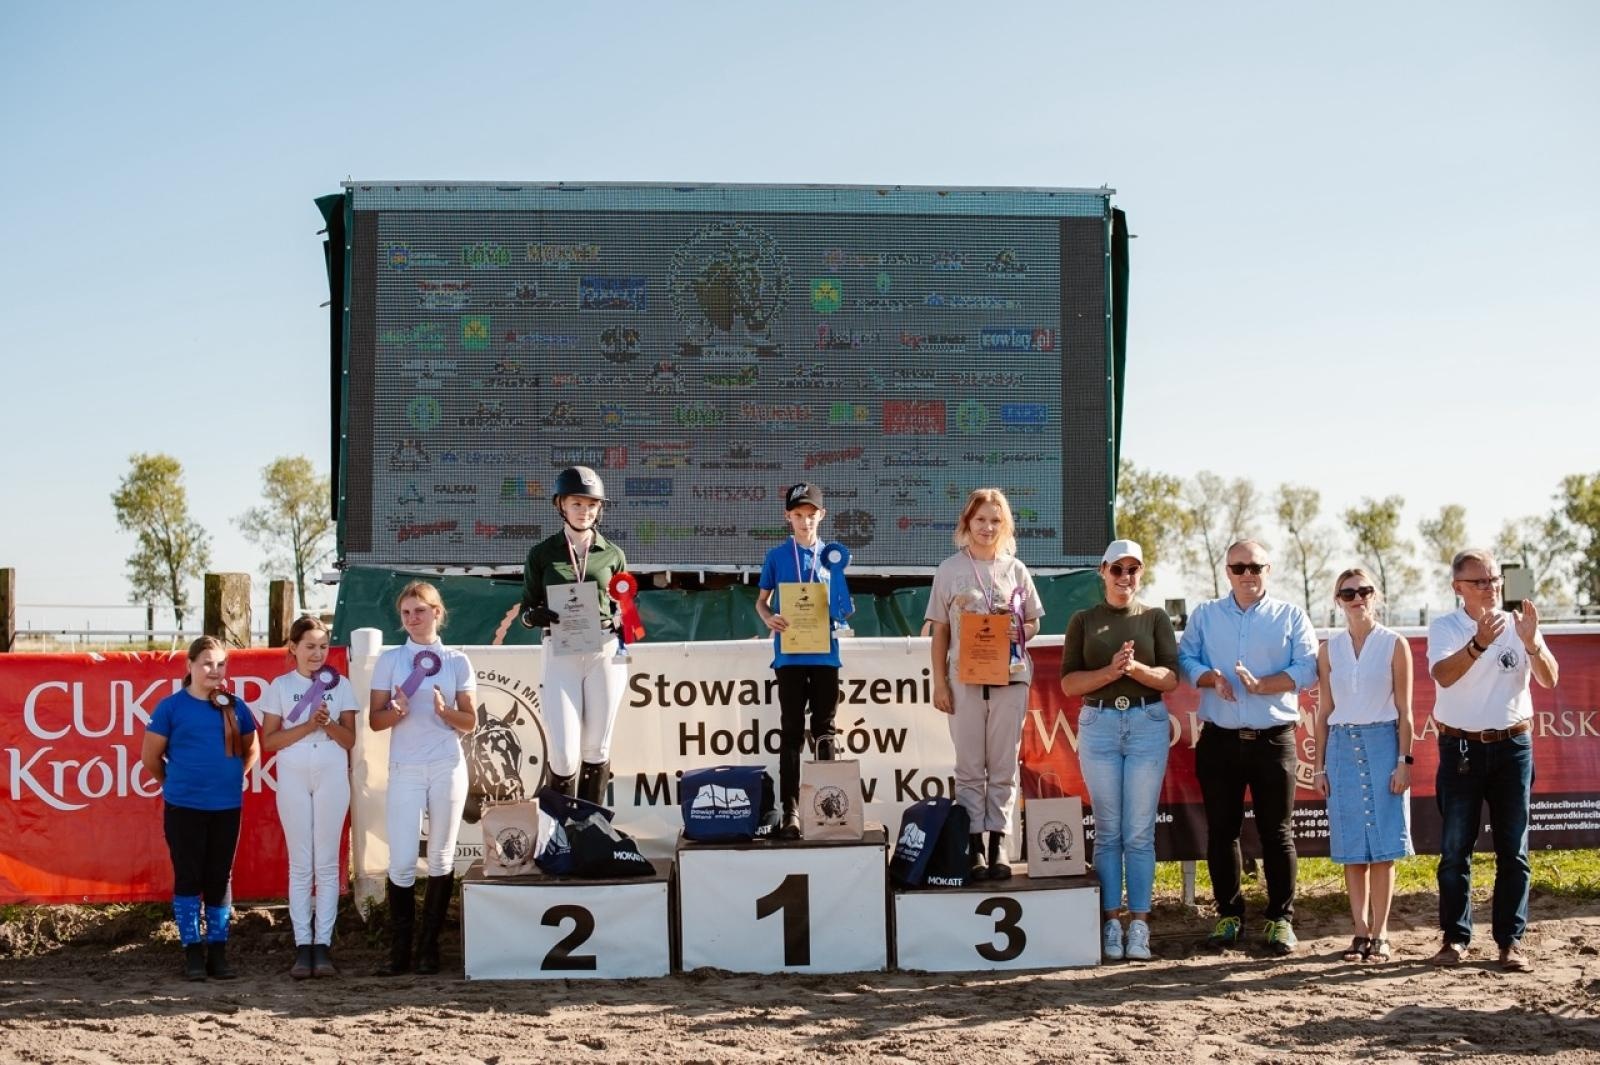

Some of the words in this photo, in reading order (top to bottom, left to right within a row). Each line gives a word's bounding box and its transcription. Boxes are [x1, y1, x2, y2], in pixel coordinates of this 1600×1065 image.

[540, 904, 597, 971] 2
[755, 873, 810, 967] 1
[974, 895, 1027, 962] 3
